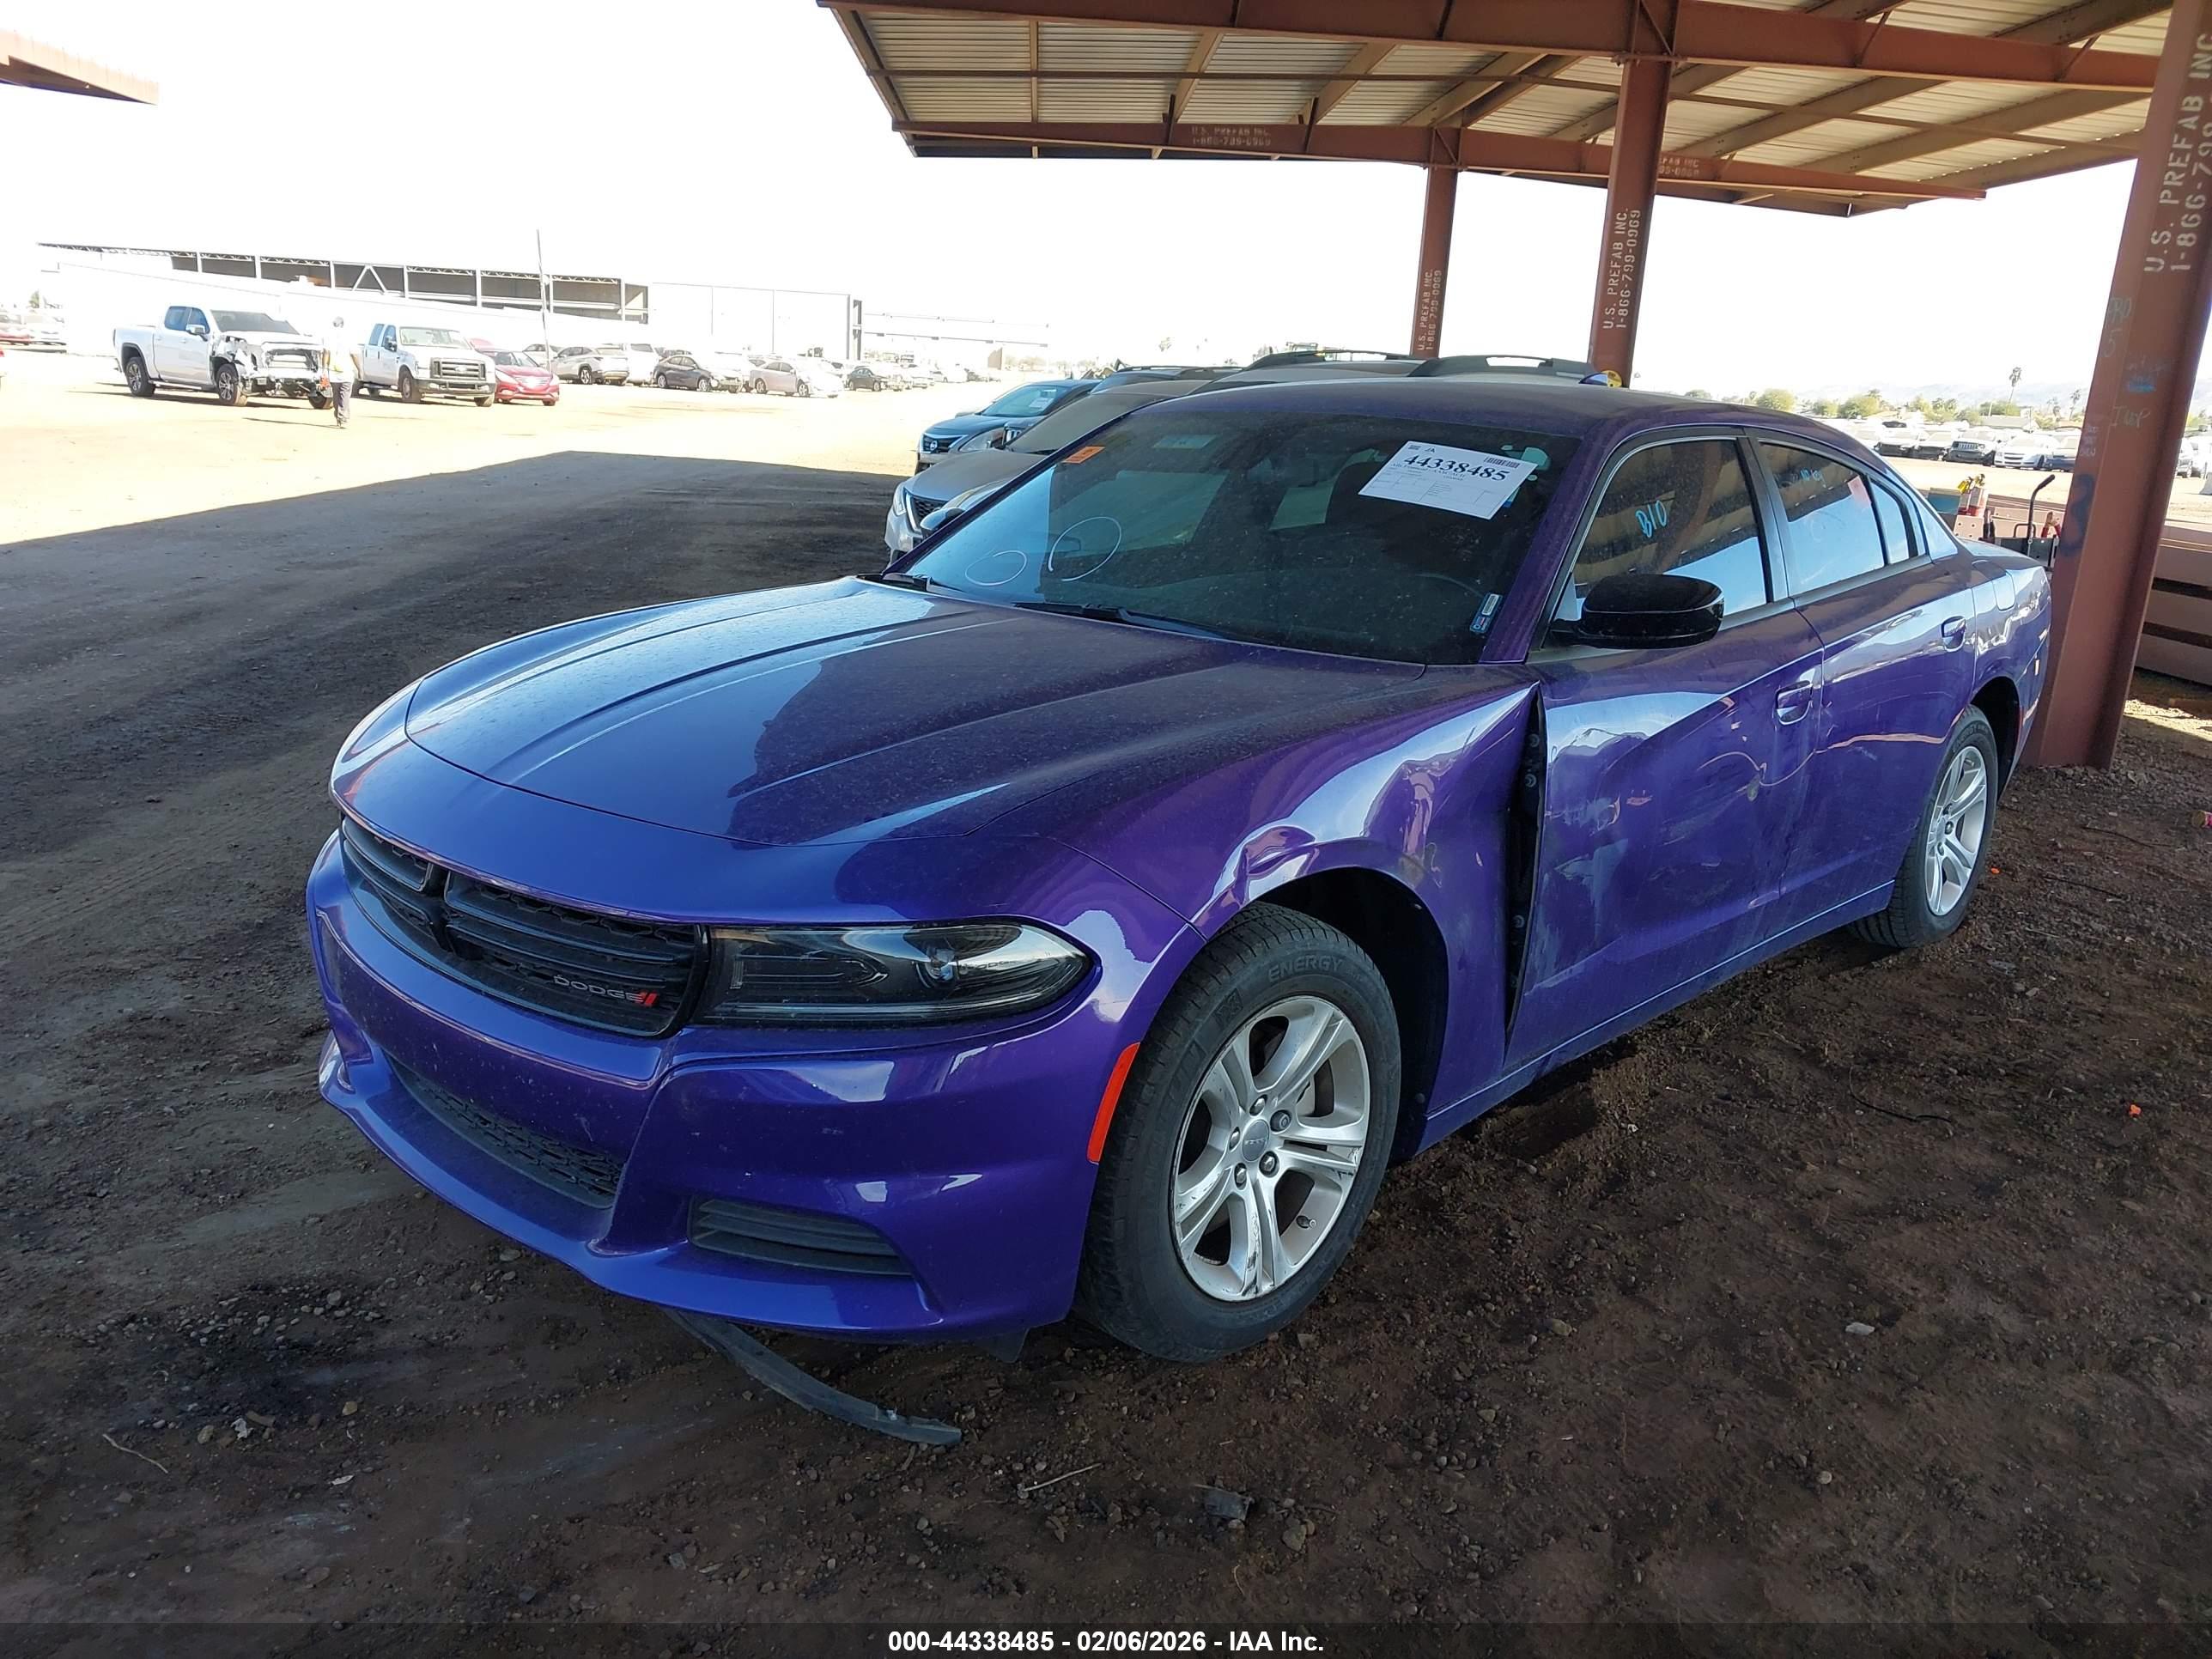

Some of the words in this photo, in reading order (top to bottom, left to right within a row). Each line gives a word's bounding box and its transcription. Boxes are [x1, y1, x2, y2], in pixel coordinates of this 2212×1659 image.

[2143, 222, 2174, 272] U.S.
[2159, 95, 2203, 204] PREFAB
[1614, 208, 1629, 234] INC.
[1607, 242, 1623, 295] PREFAB
[1615, 210, 1641, 328] 1-866-799-0969
[1419, 292, 1431, 328] PREFAB
[1602, 303, 1616, 329] U.S.
[1417, 332, 1427, 350] U.S.
[1404, 454, 1510, 481] 44338485
[1267, 954, 1344, 981] ENERGY
[553, 975, 645, 1003] DODGE
